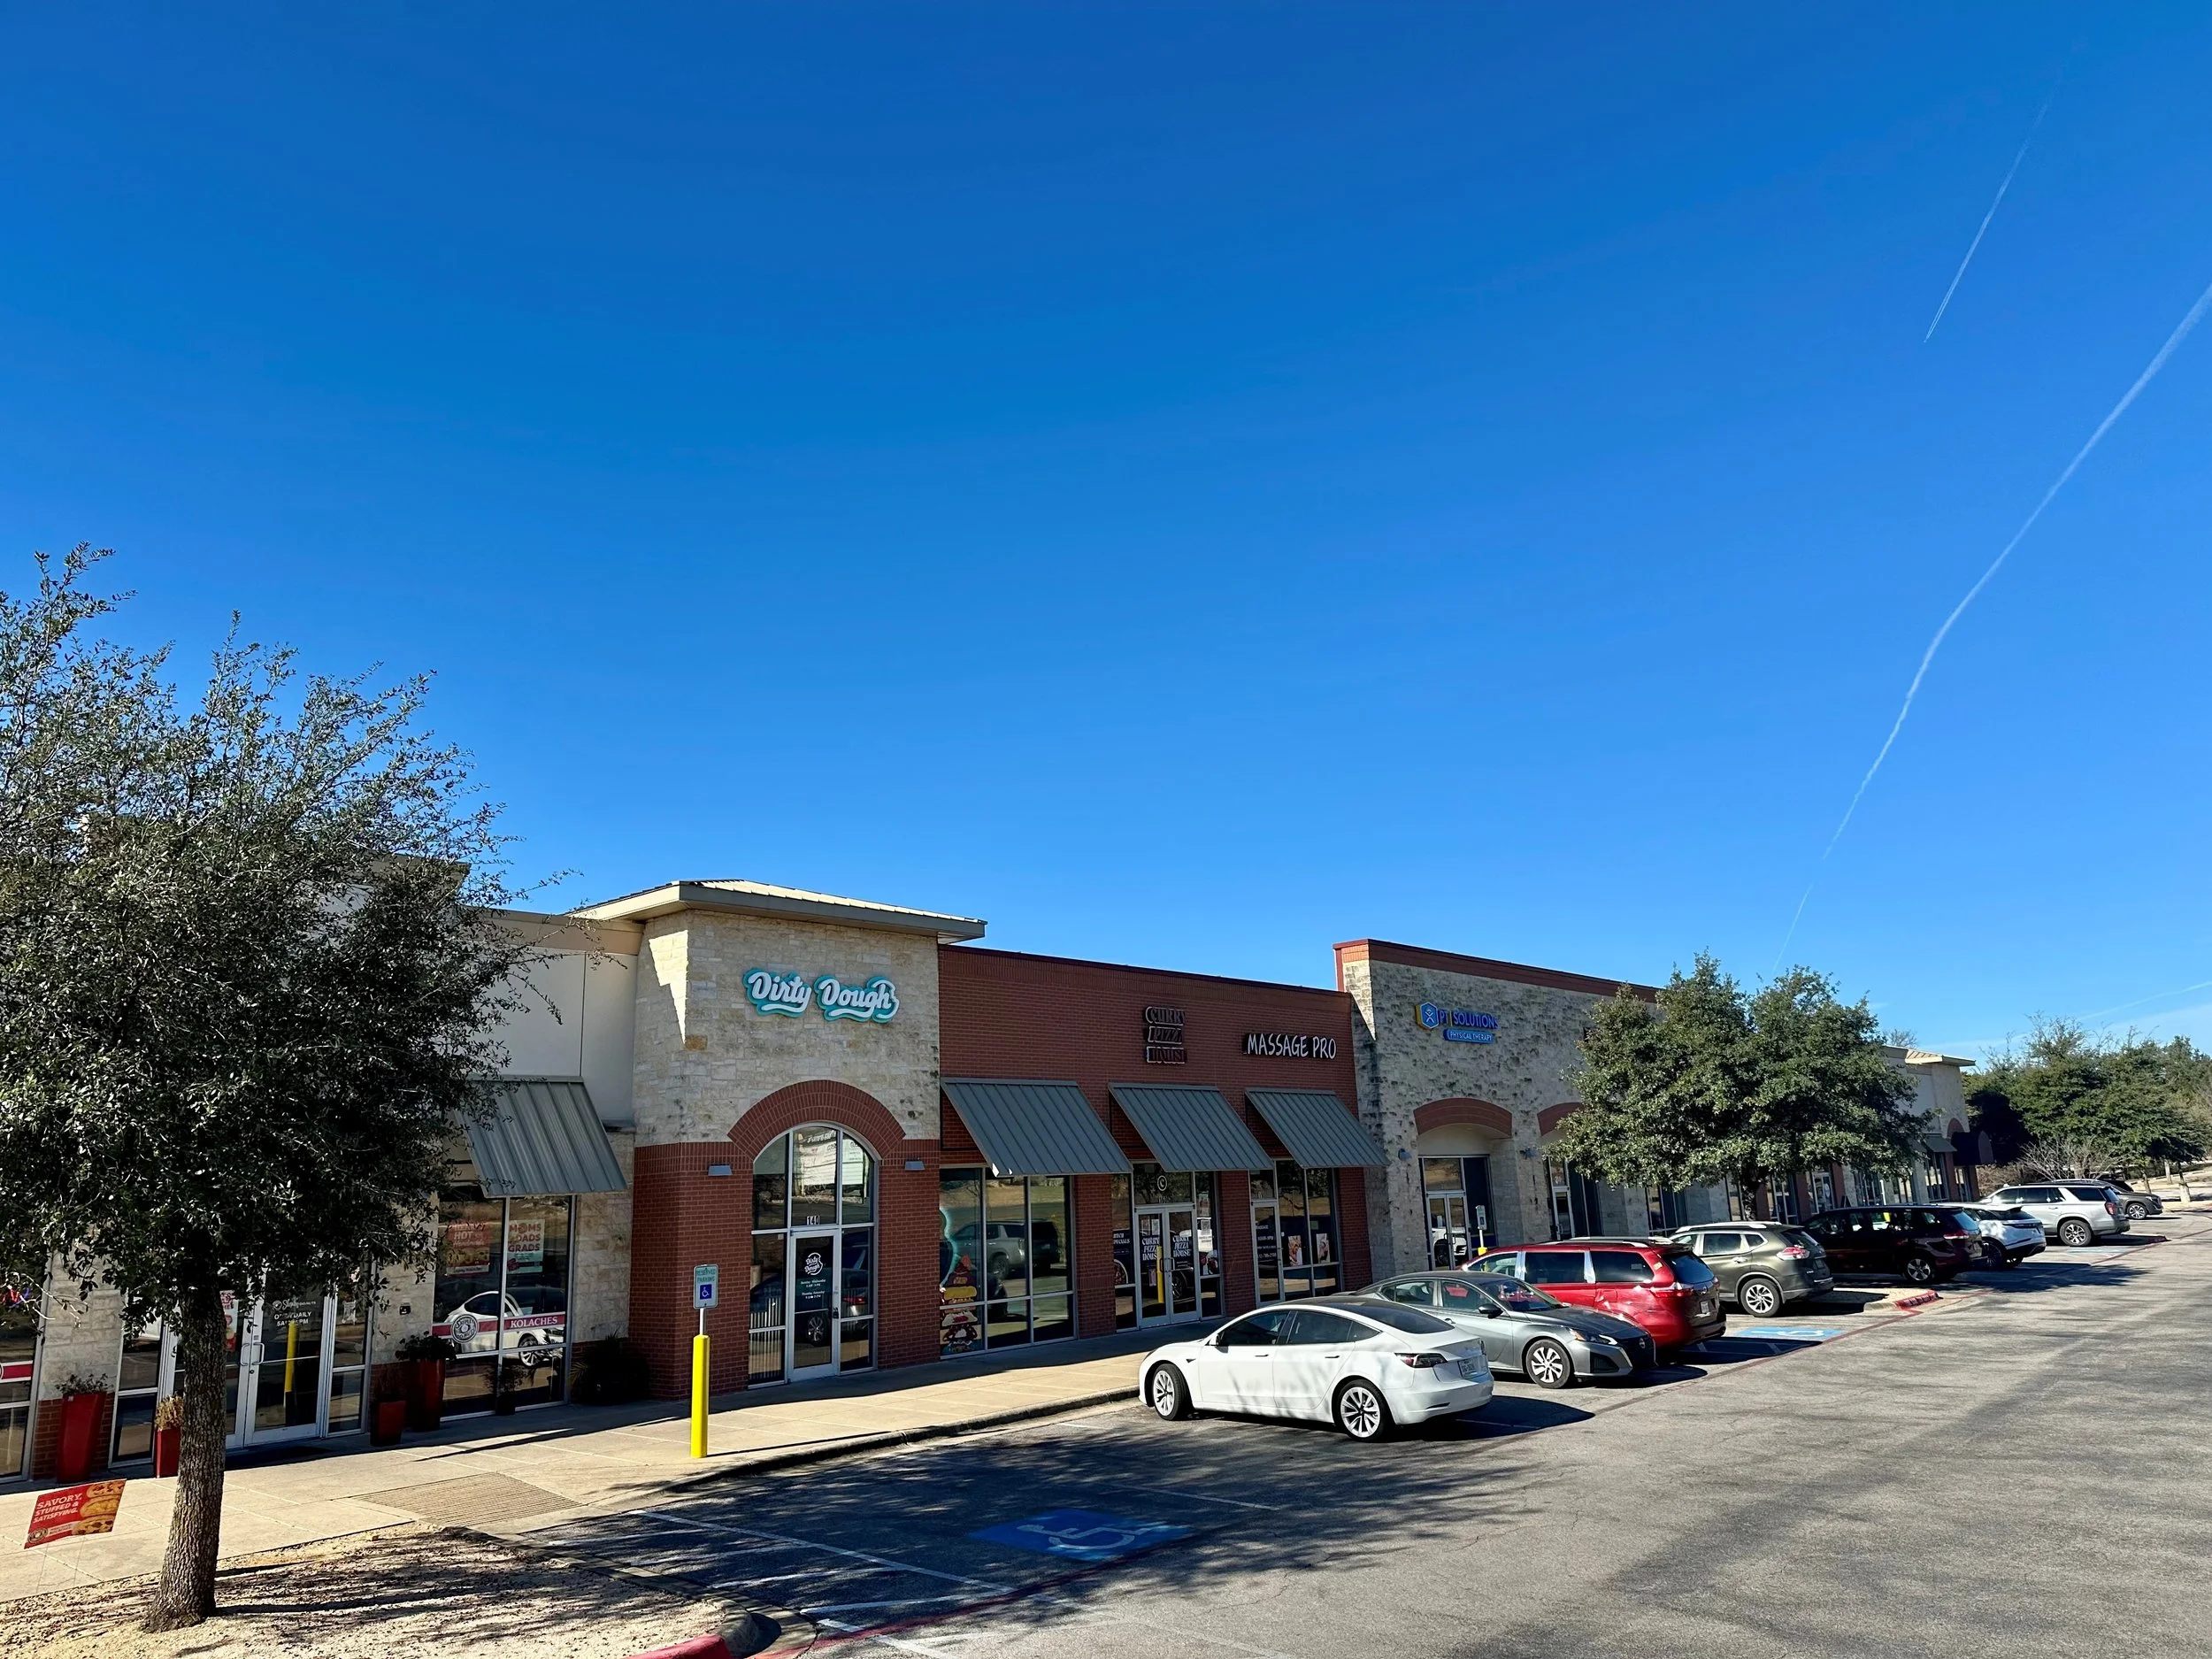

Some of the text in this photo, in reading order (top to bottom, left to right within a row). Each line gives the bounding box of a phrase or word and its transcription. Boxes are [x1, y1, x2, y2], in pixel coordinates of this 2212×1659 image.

[748, 972, 898, 1018] Dirty Dough
[1453, 1011, 1502, 1028] SOLUTIONS
[1450, 1031, 1492, 1041] PHYSICAL THERAPY
[1248, 1033, 1337, 1059] MASSAGE PRO
[806, 1215, 820, 1225] 140
[454, 1231, 474, 1240] HOT
[1141, 1237, 1160, 1246] CURRY
[508, 1243, 541, 1253] GRADS
[510, 1316, 558, 1329] KOLACHES
[33, 1507, 79, 1524] SATISFYING.
[35, 1503, 71, 1517] STUFFED
